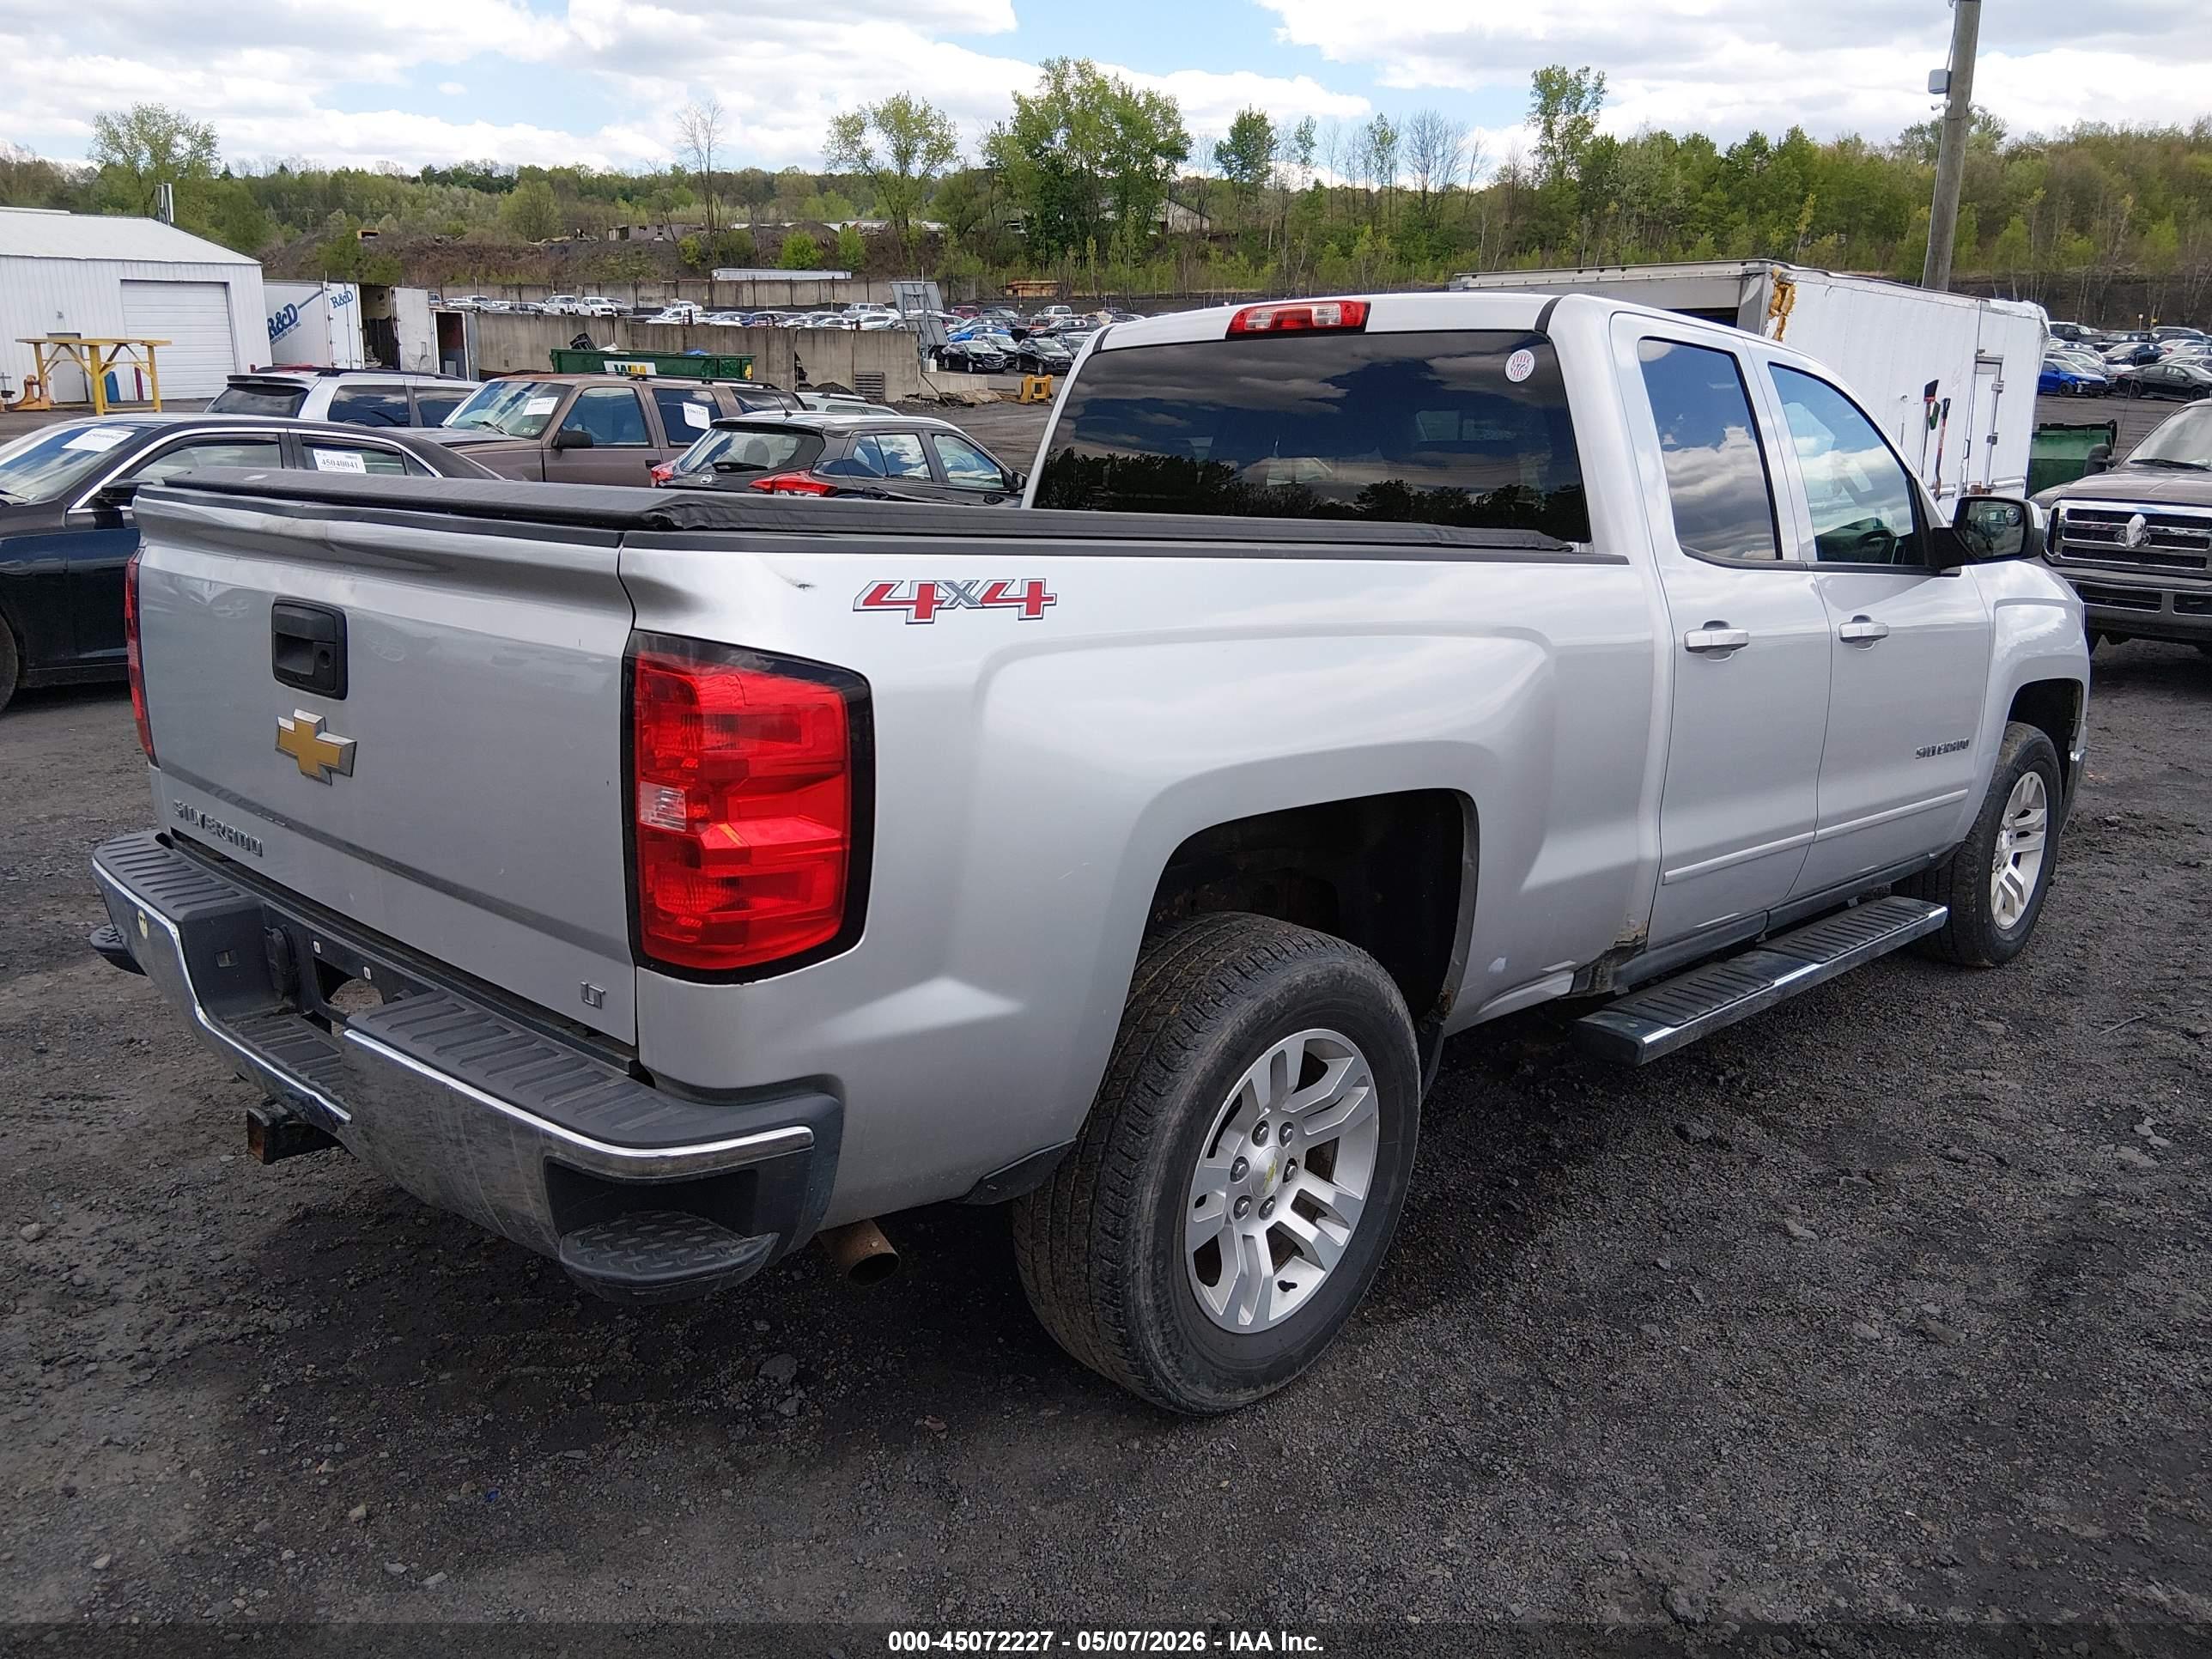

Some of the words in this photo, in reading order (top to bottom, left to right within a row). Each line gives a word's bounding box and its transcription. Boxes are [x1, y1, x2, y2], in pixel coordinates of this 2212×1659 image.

[330, 290, 354, 308] R&D
[267, 303, 298, 340] R&D
[172, 799, 263, 858] SILVERADO
[580, 981, 606, 1010] LT
